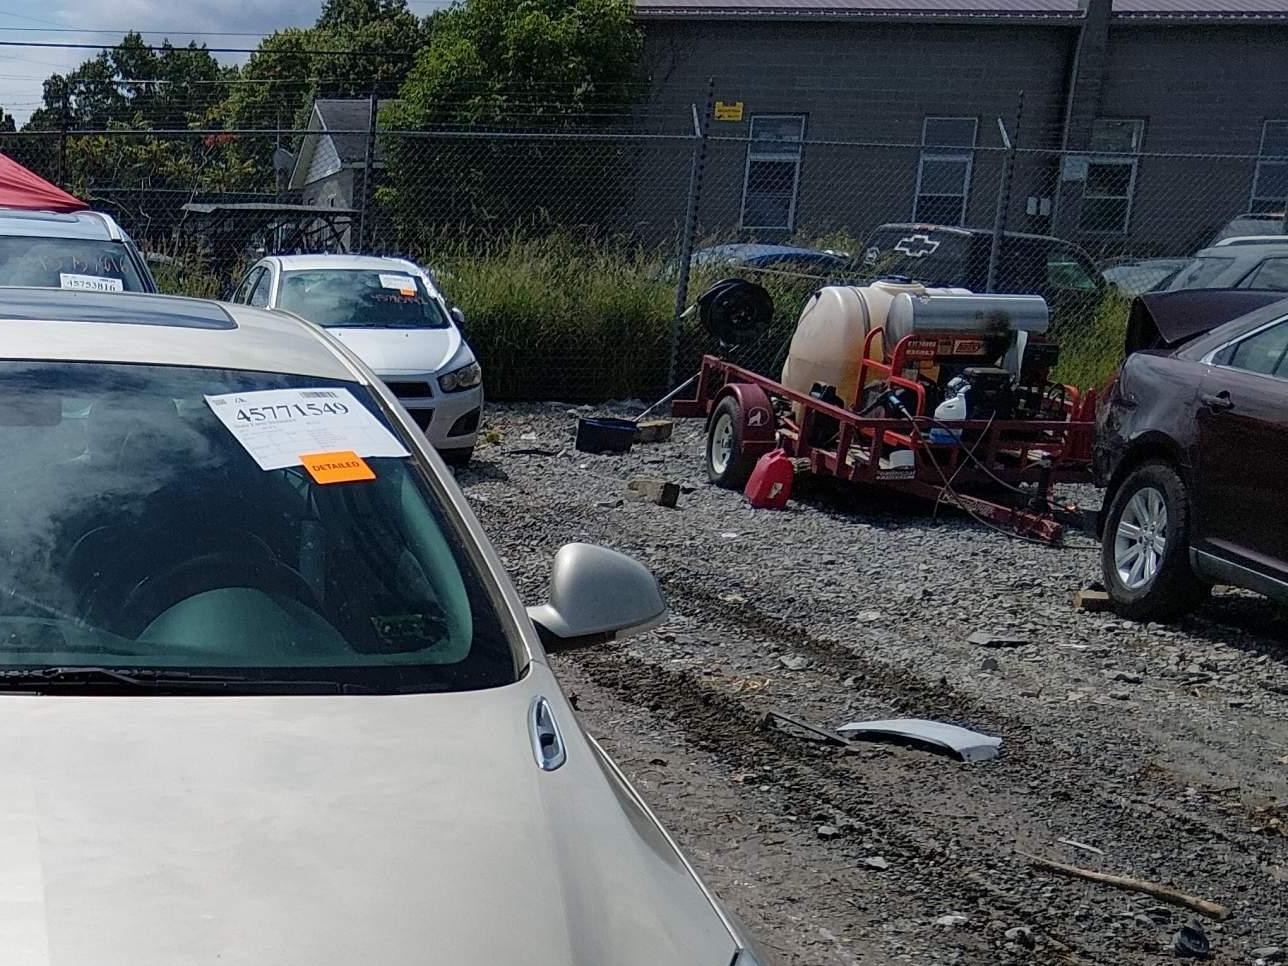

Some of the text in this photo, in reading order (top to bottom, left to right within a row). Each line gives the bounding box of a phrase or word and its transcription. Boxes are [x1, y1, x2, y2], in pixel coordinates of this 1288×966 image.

[67, 279, 116, 291] 45753816
[237, 402, 349, 422] 45771549
[312, 461, 360, 472] DETAILED
